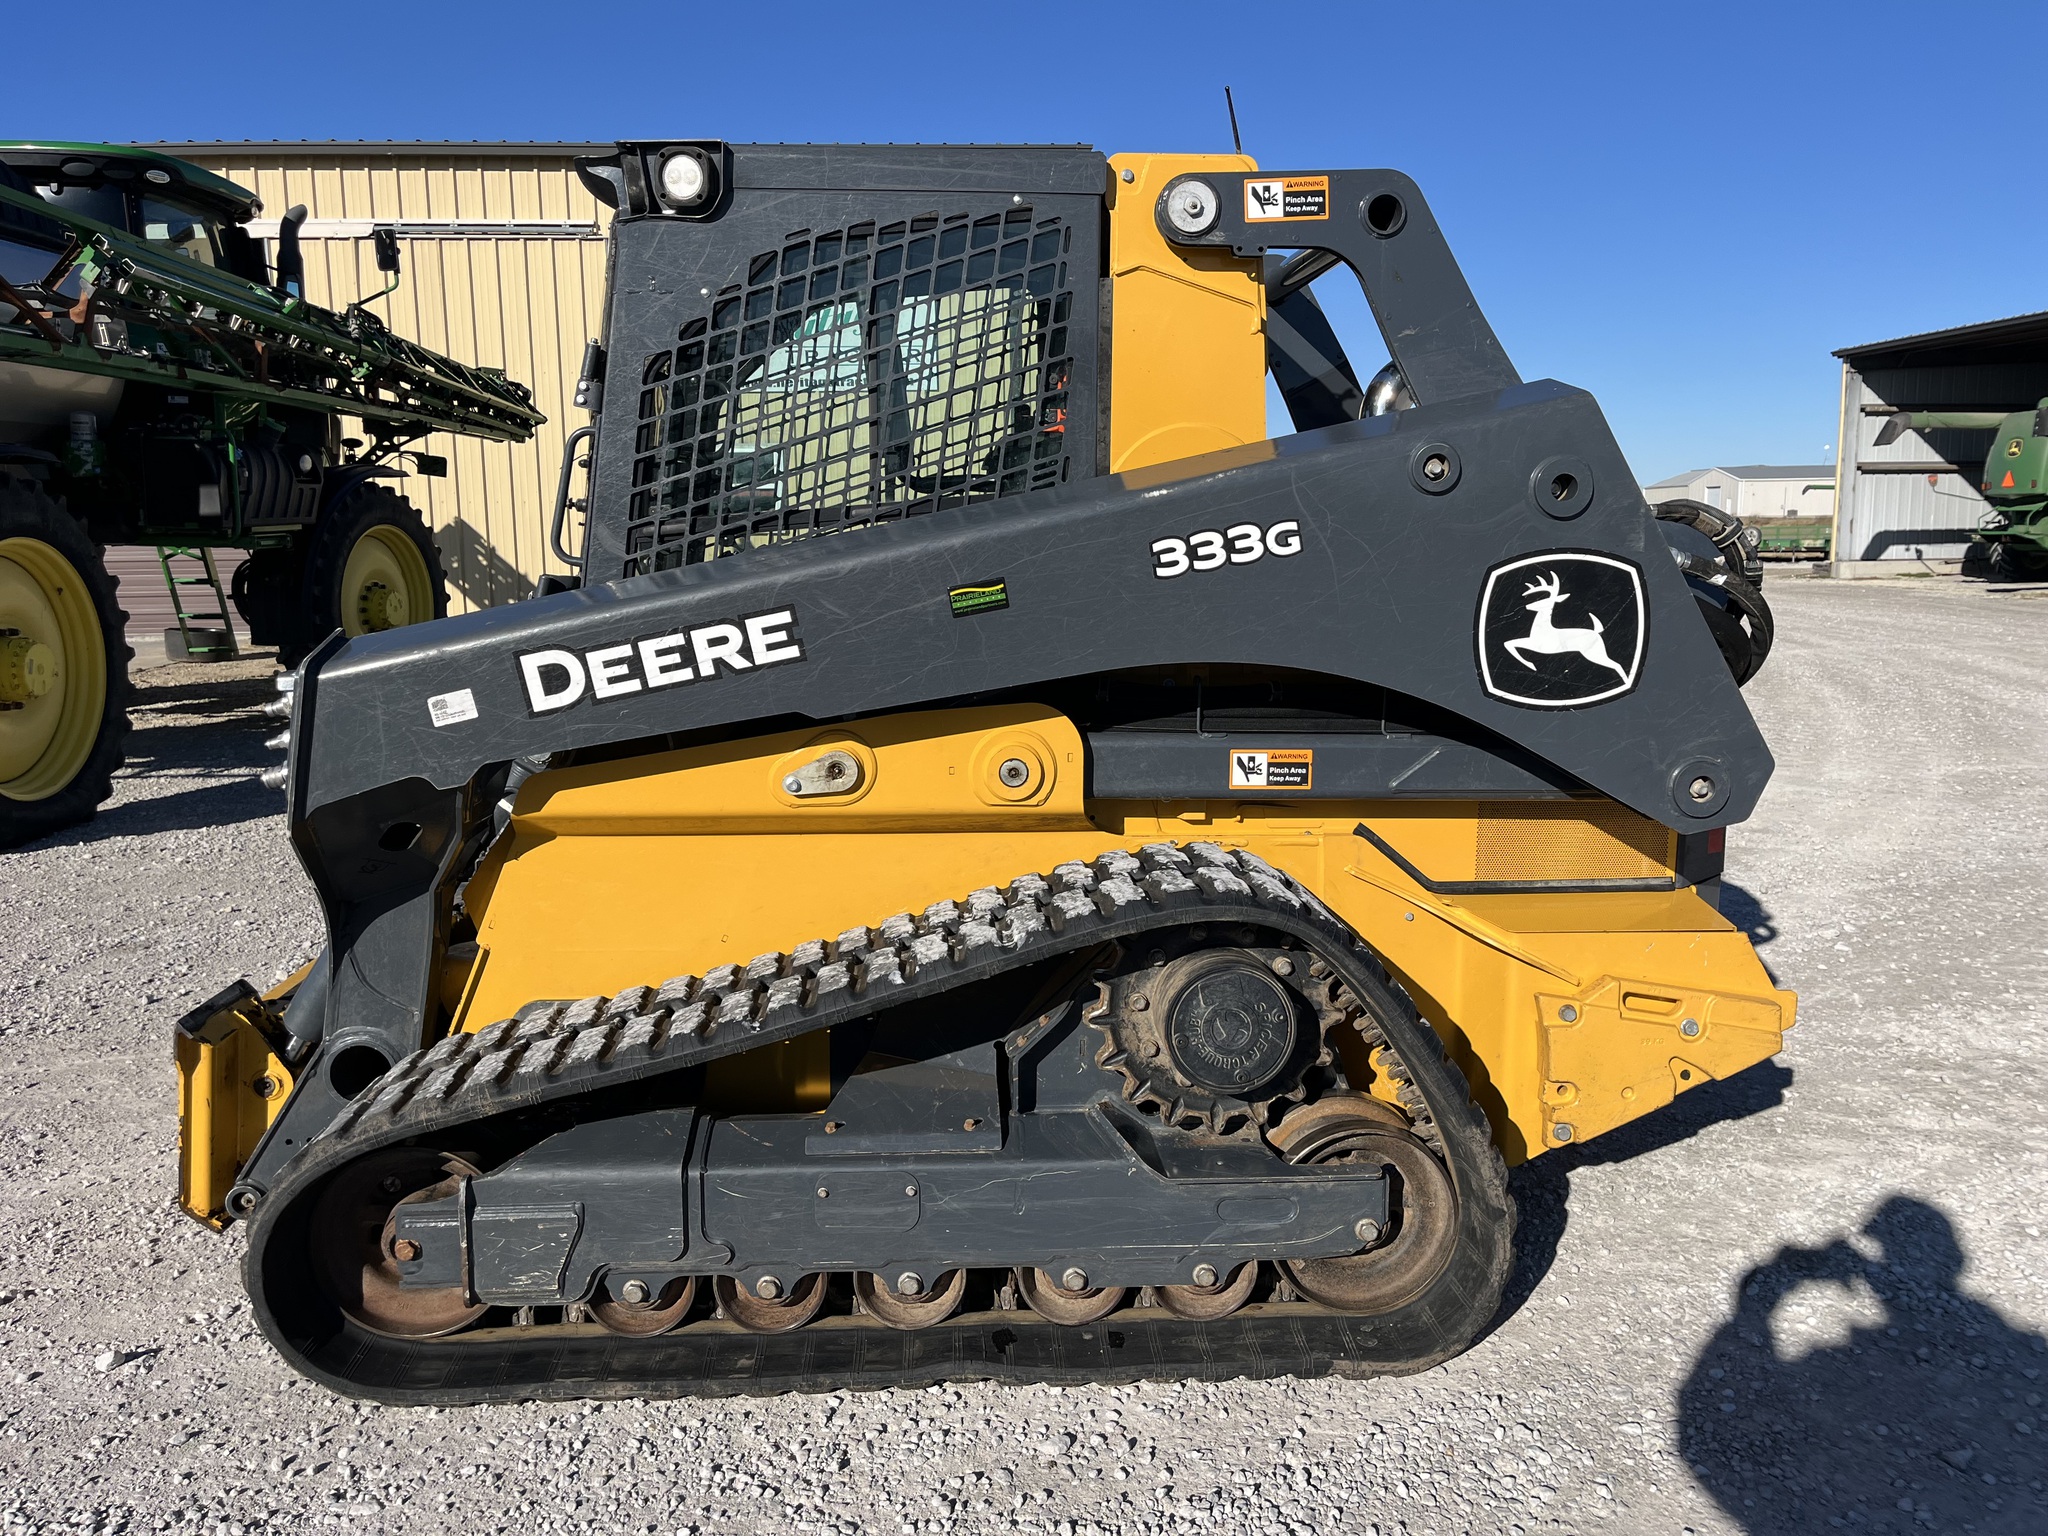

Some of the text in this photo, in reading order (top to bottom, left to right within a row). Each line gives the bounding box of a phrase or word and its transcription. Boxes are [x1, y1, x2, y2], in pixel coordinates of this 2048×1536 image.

[1285, 196, 1306, 204] Pinch
[1151, 521, 1302, 577] 333G
[519, 610, 801, 712] DEERE
